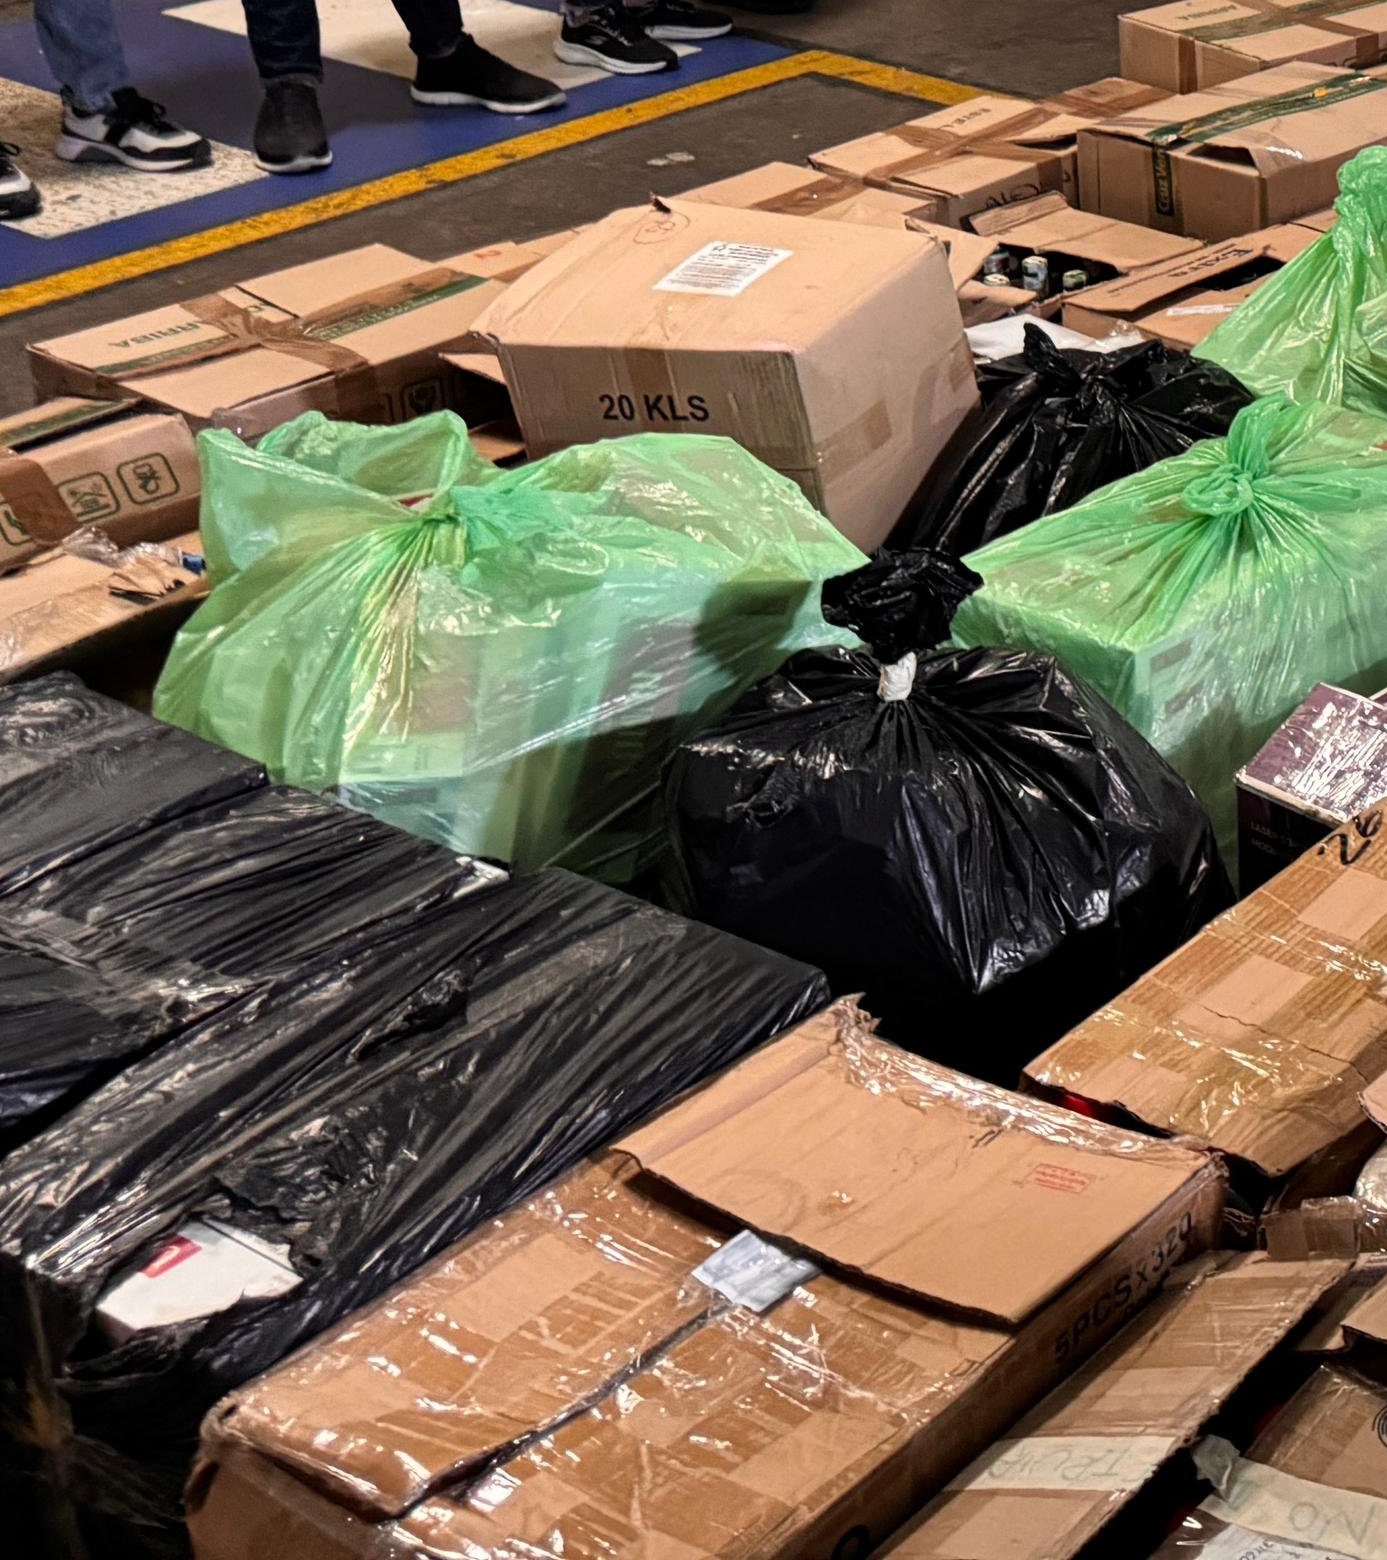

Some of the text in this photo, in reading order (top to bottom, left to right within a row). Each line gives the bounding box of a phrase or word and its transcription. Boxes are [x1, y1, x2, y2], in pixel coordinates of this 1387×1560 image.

[109, 321, 202, 349] RRIBA
[599, 393, 710, 423] 20 KLS
